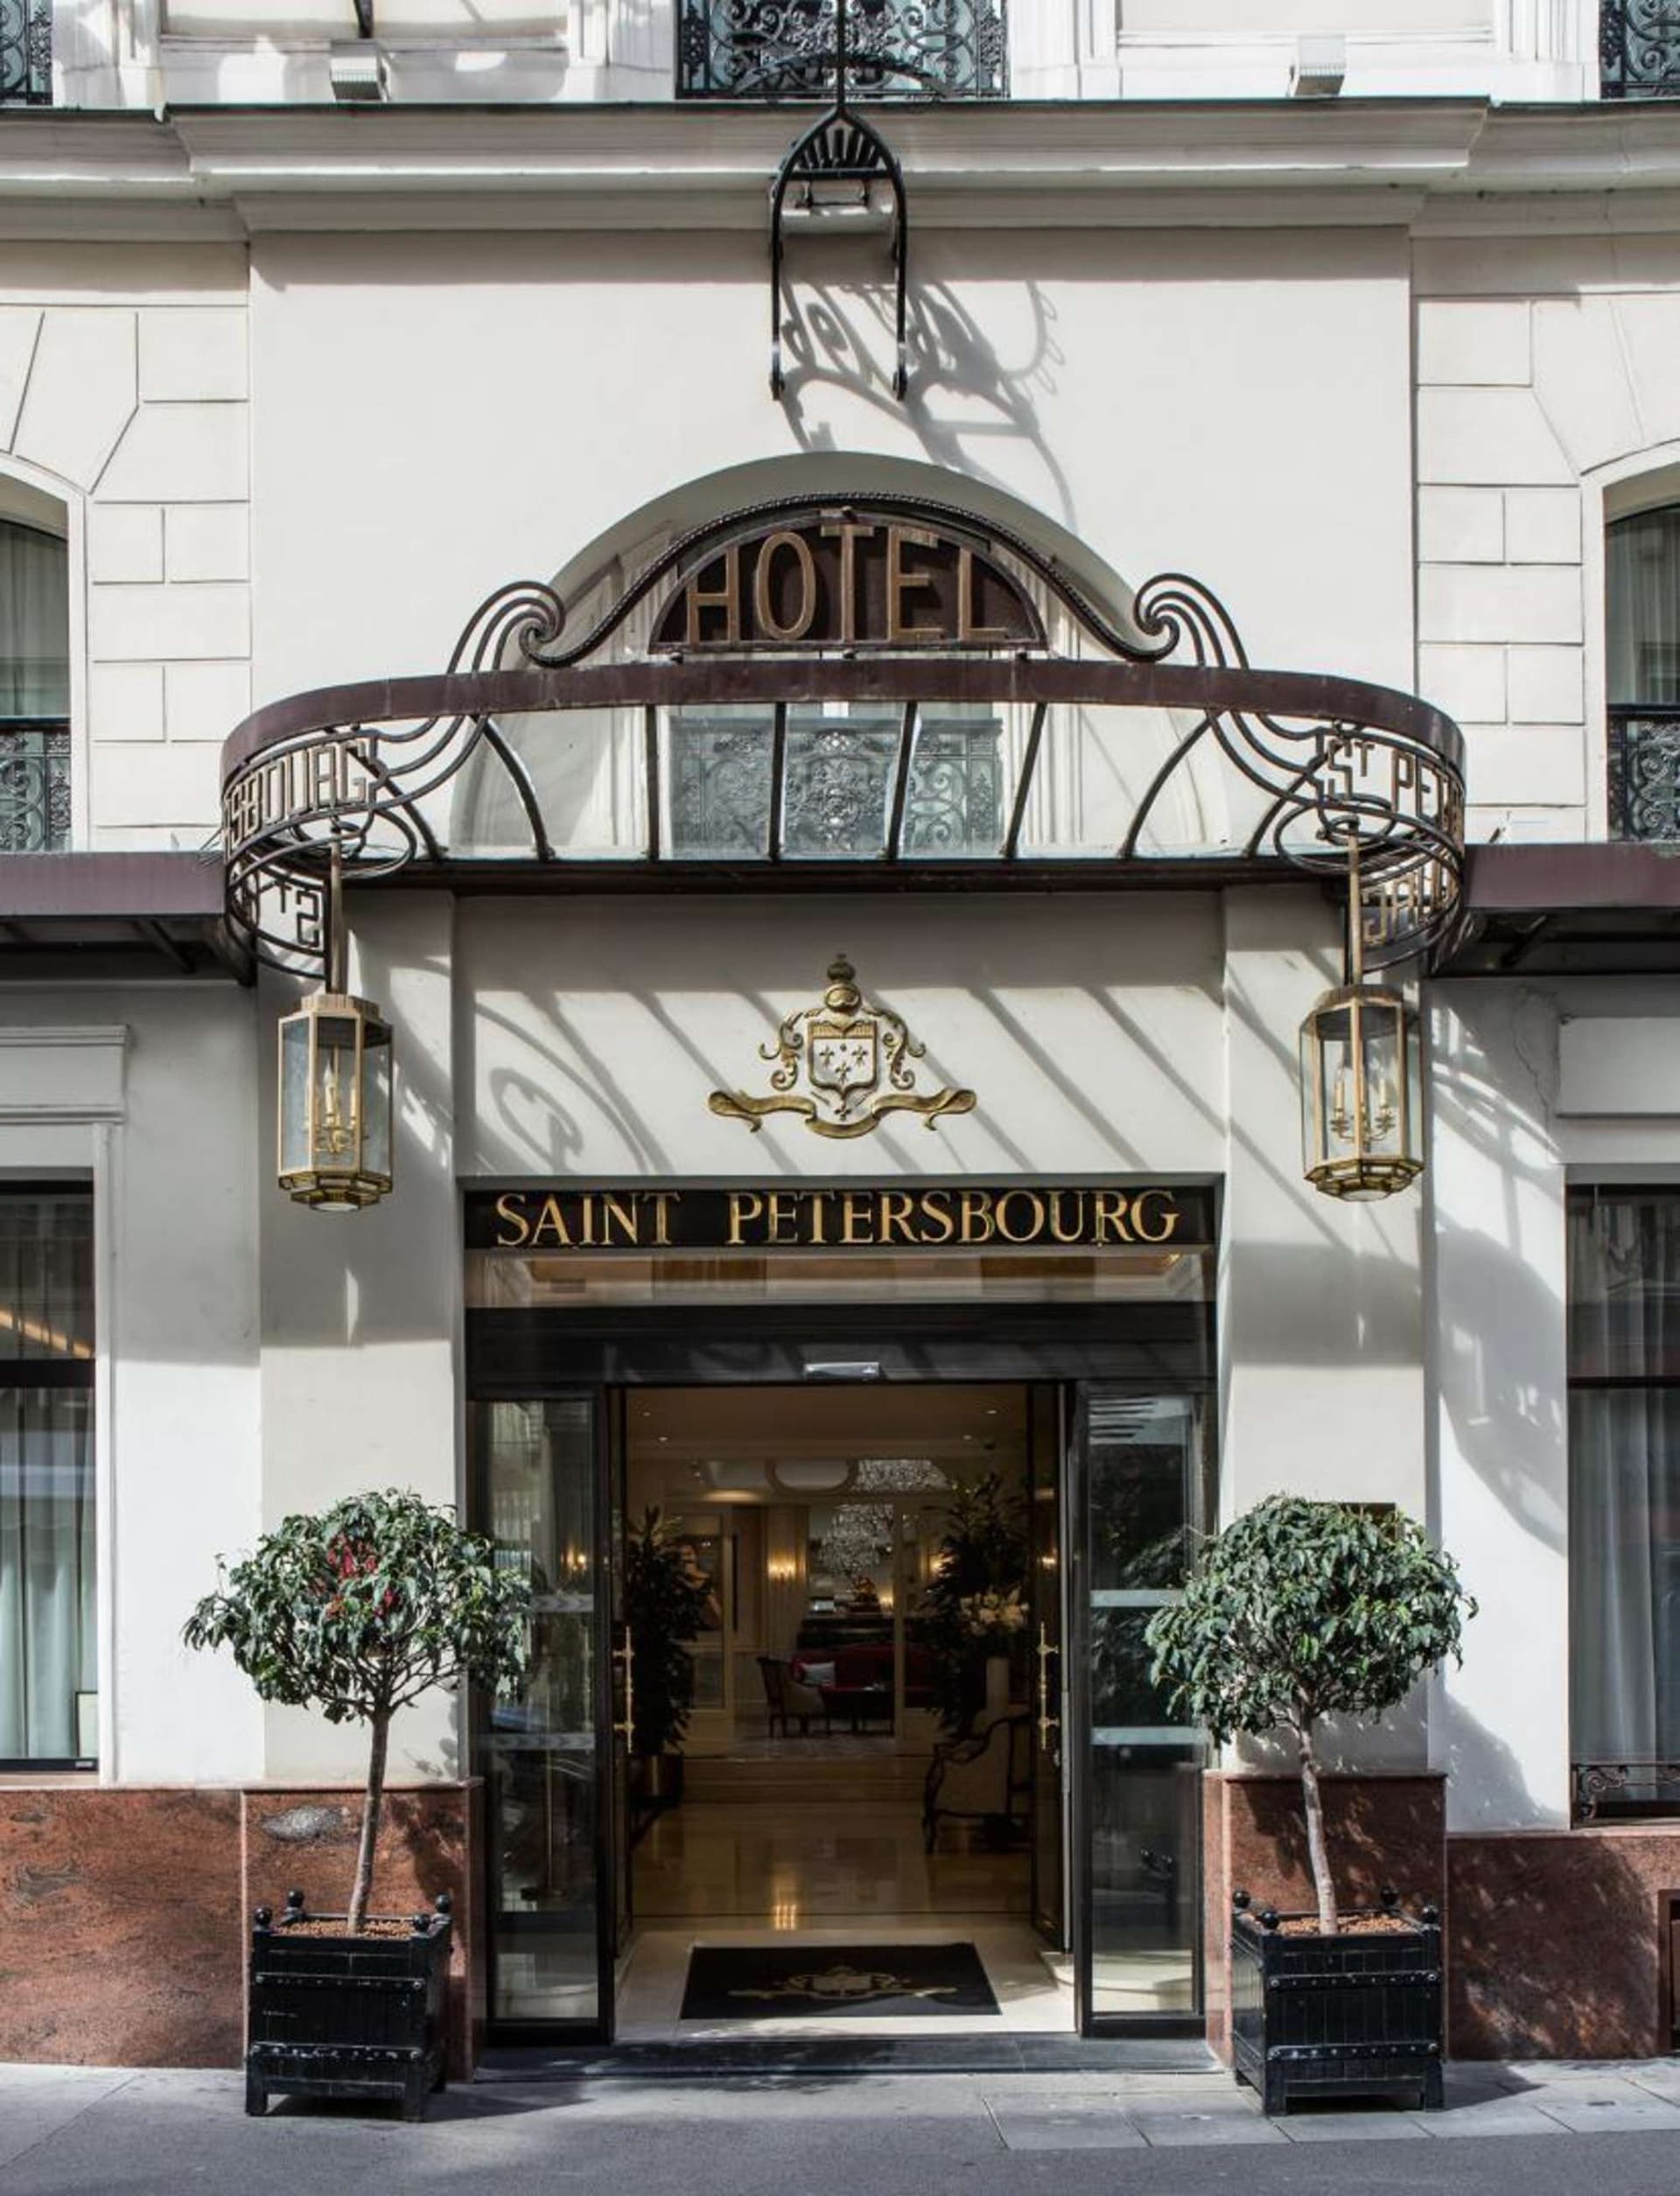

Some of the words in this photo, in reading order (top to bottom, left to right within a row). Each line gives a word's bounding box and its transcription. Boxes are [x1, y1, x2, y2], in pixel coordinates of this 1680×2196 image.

[685, 523, 1008, 647] HOTEL
[494, 1190, 682, 1247] SAINT
[724, 1189, 1180, 1245] PETERSBOURG
